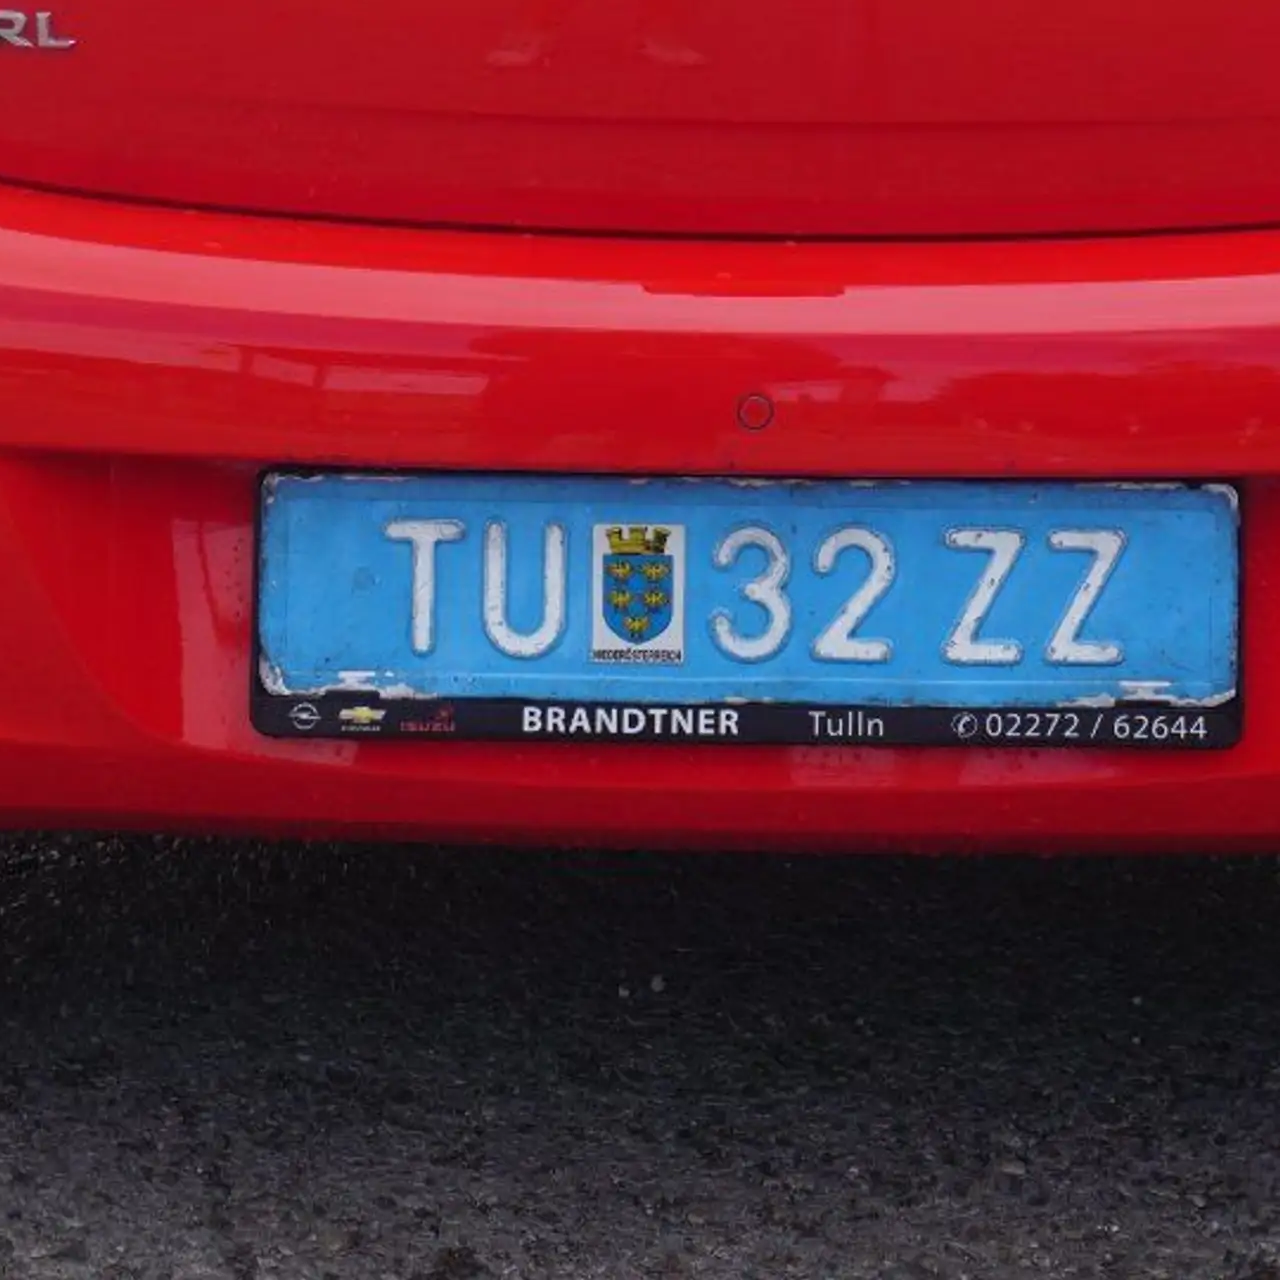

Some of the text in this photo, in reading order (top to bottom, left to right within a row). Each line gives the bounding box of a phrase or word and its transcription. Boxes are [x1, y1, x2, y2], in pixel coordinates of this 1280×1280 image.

[383, 519, 1128, 667] TU 32 ZZ
[521, 706, 740, 736] BRANDTNER
[809, 710, 885, 738] Tulln
[985, 713, 1080, 738] 02272
[1113, 715, 1208, 740] 62644
